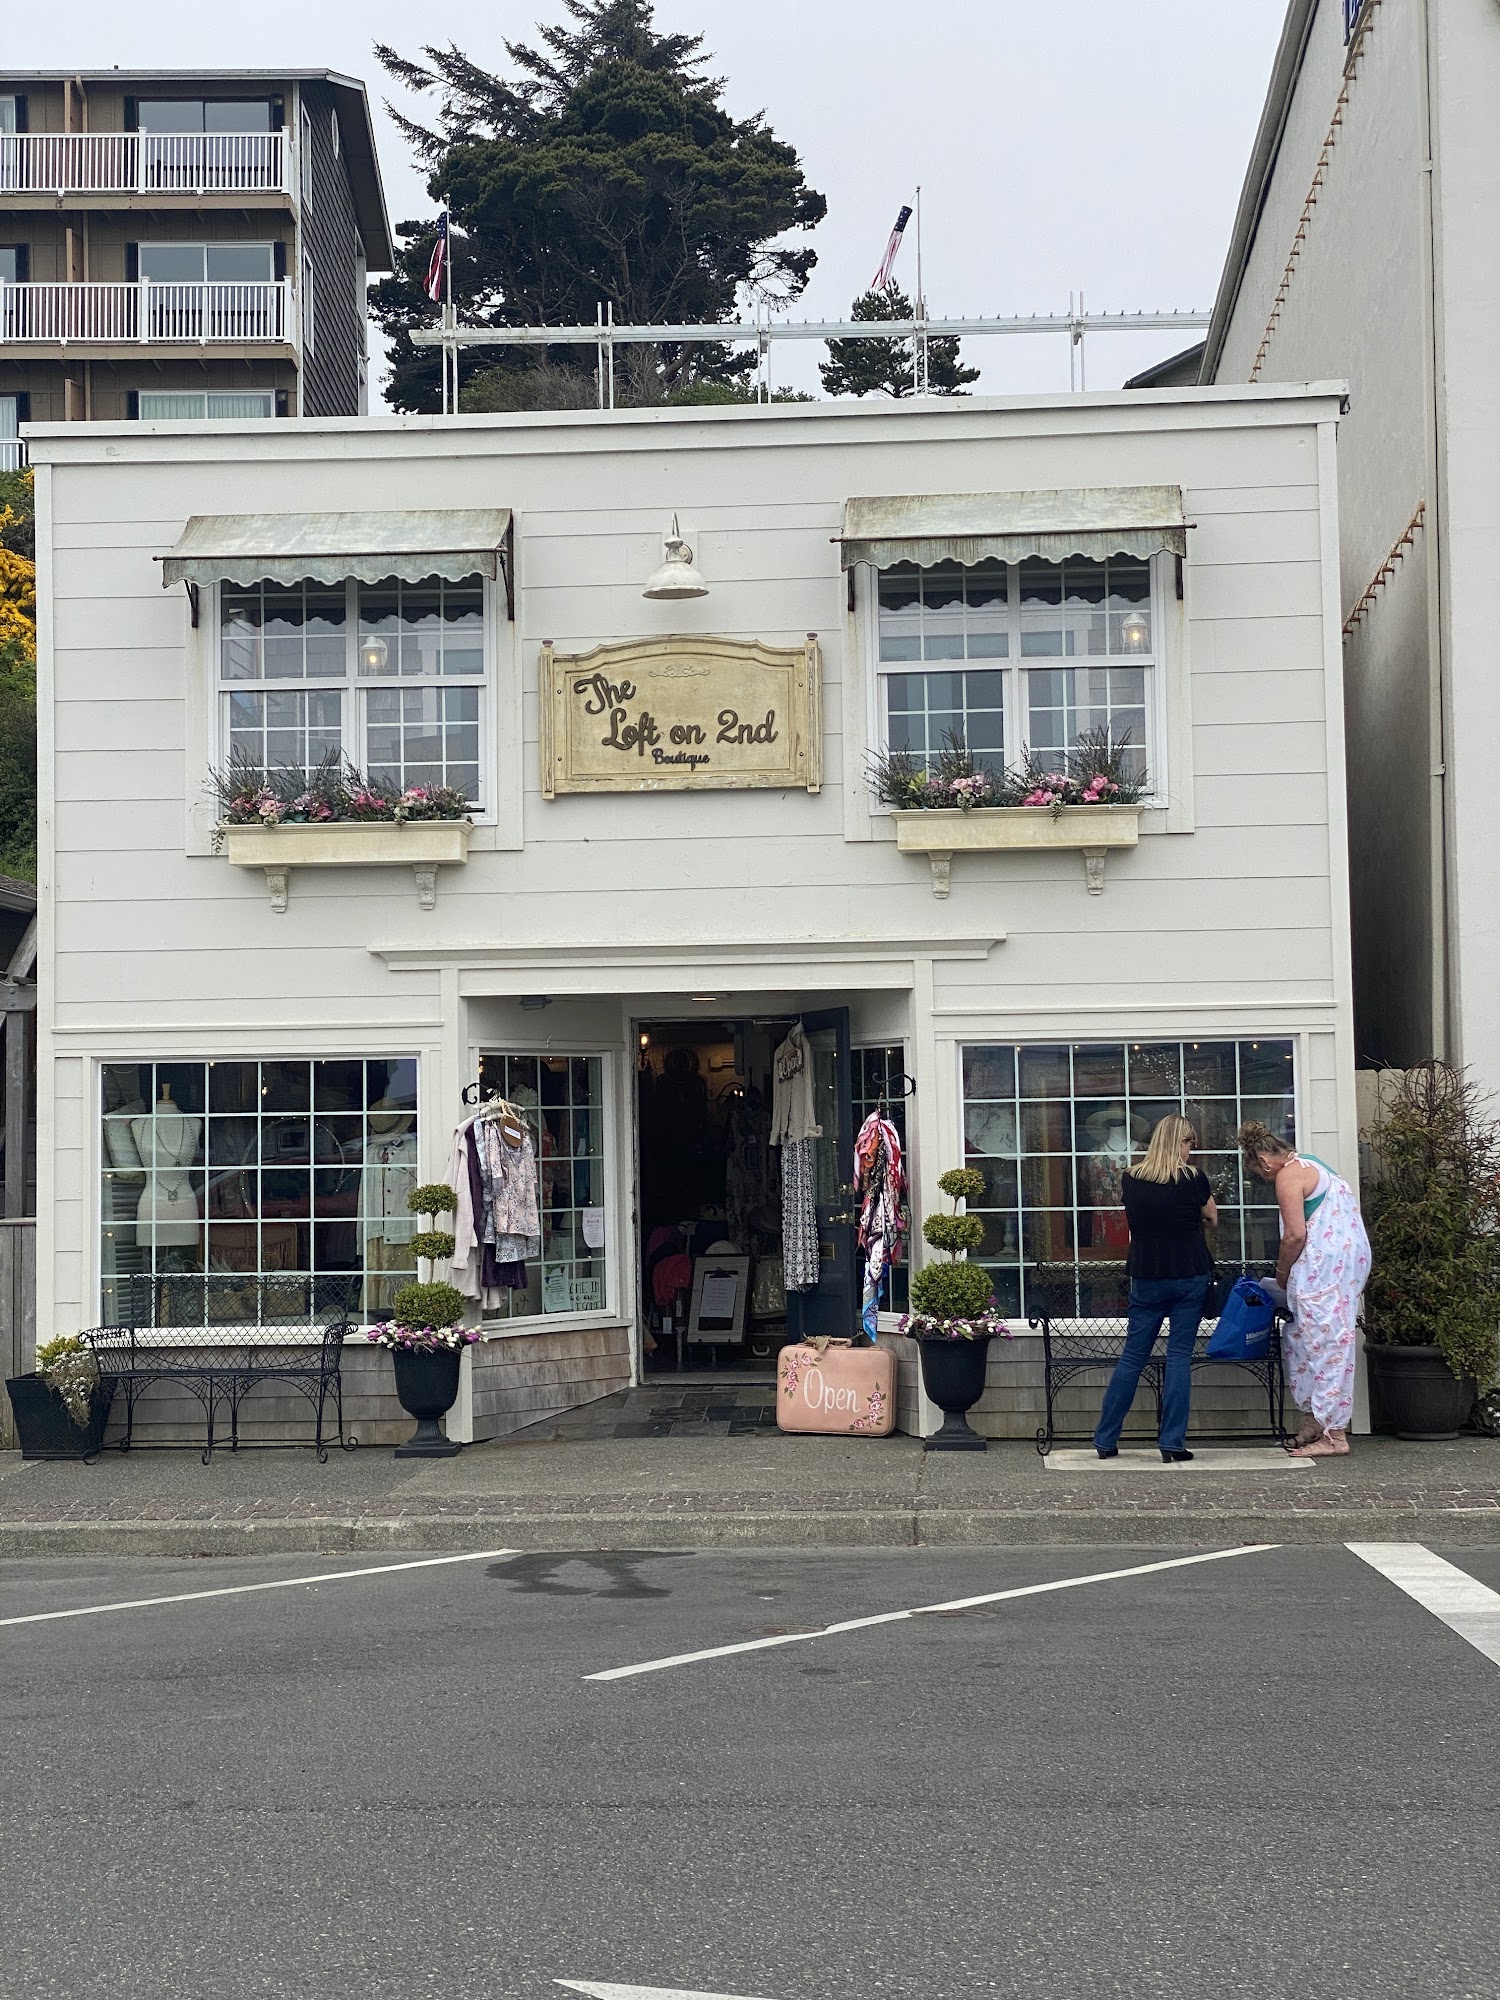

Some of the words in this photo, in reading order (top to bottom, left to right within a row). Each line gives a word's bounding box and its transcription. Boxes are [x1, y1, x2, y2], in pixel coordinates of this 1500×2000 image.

[573, 673, 637, 715] The
[601, 707, 661, 756] Loft
[669, 725, 707, 745] on
[716, 709, 779, 744] 2nd
[651, 748, 711, 772] Boutique
[803, 1368, 861, 1414] Open
